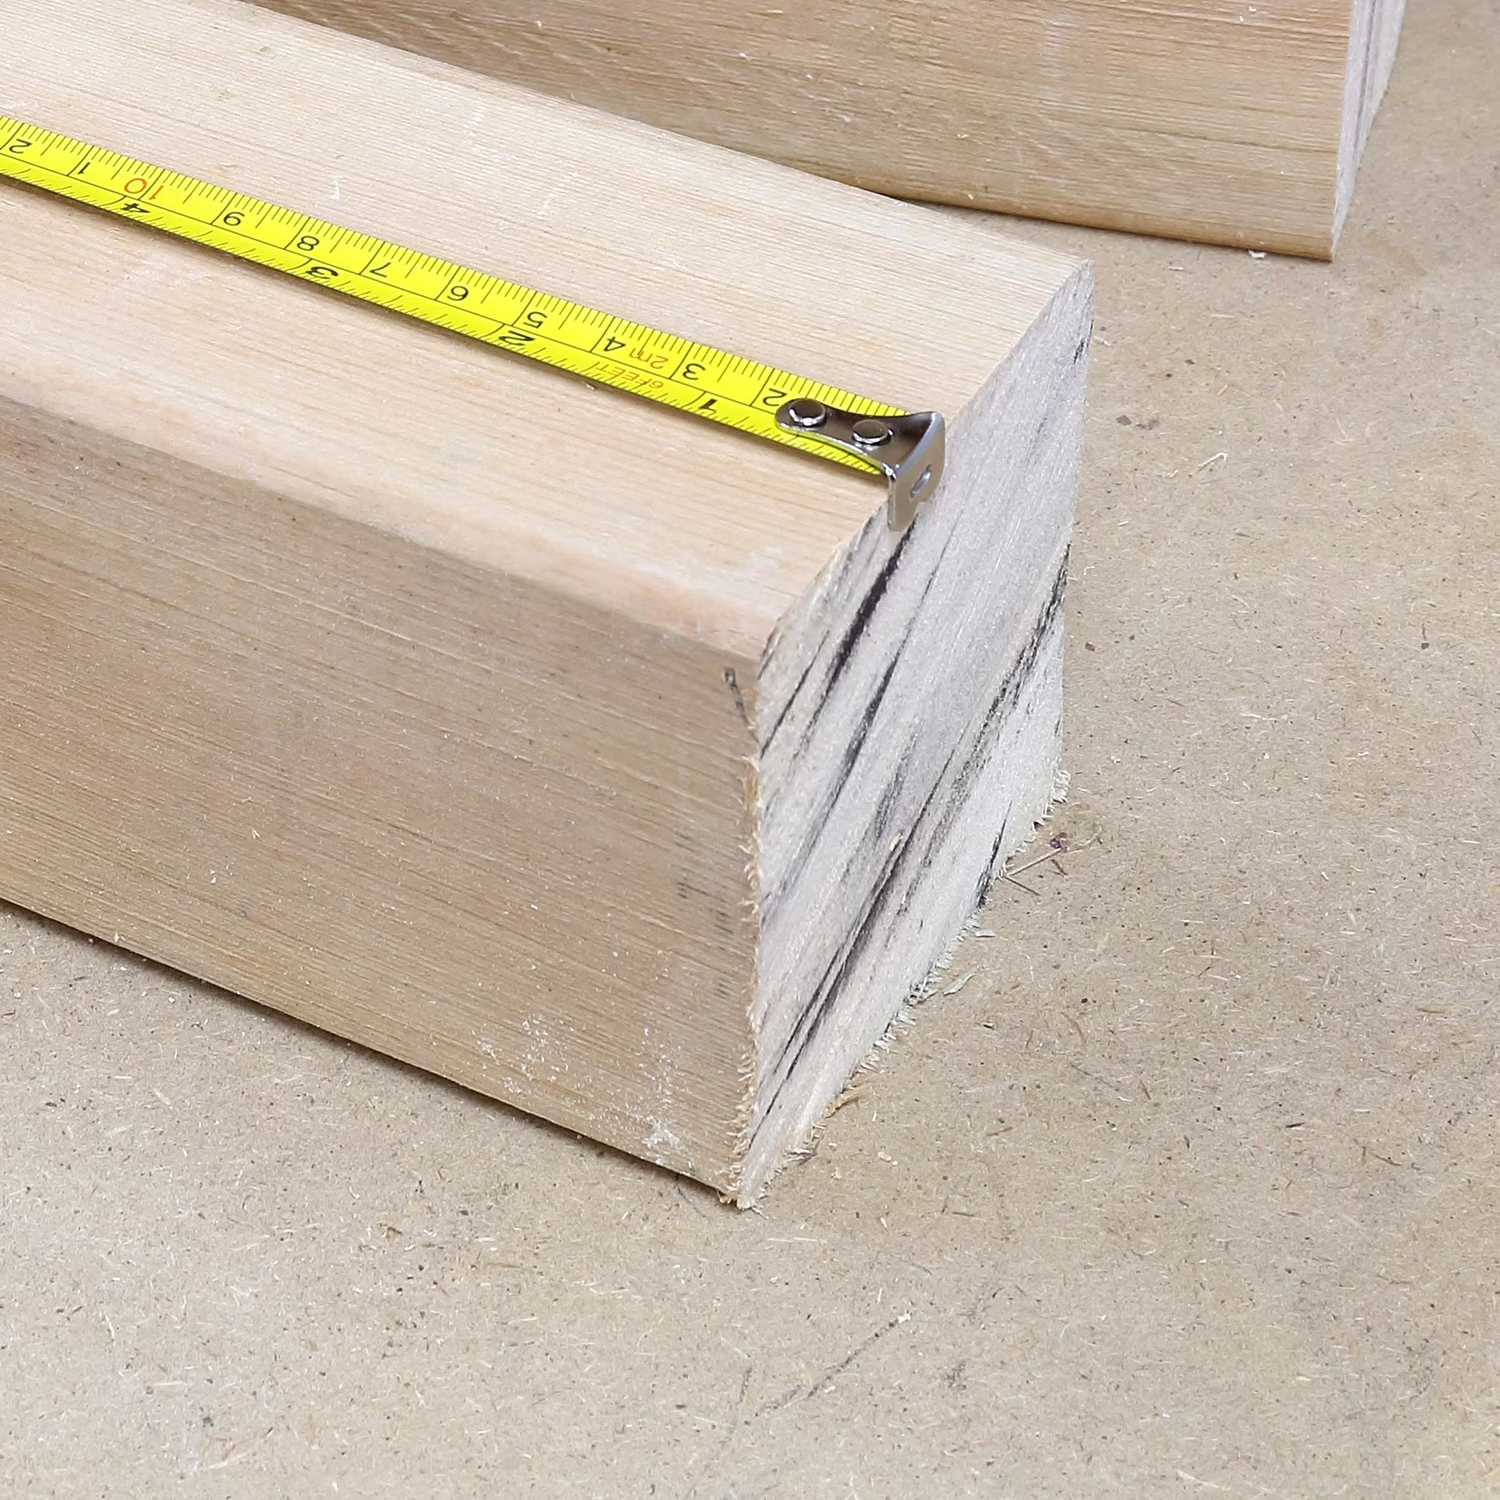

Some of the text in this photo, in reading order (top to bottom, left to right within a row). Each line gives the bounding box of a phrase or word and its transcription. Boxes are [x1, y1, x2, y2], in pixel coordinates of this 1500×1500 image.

[8, 138, 33, 154] 2
[77, 161, 91, 175] 1
[123, 177, 164, 201] 10
[121, 202, 150, 214] 4
[223, 211, 245, 226] 9
[296, 235, 320, 251] 8
[305, 266, 339, 280] 3
[369, 262, 391, 278] 7
[447, 285, 469, 301] 6
[523, 311, 547, 329] 5
[498, 330, 536, 347] 2
[603, 336, 626, 352] 4
[628, 347, 669, 370] 2m
[682, 363, 706, 381] 3
[762, 388, 788, 407] 2
[698, 398, 718, 414] 1
